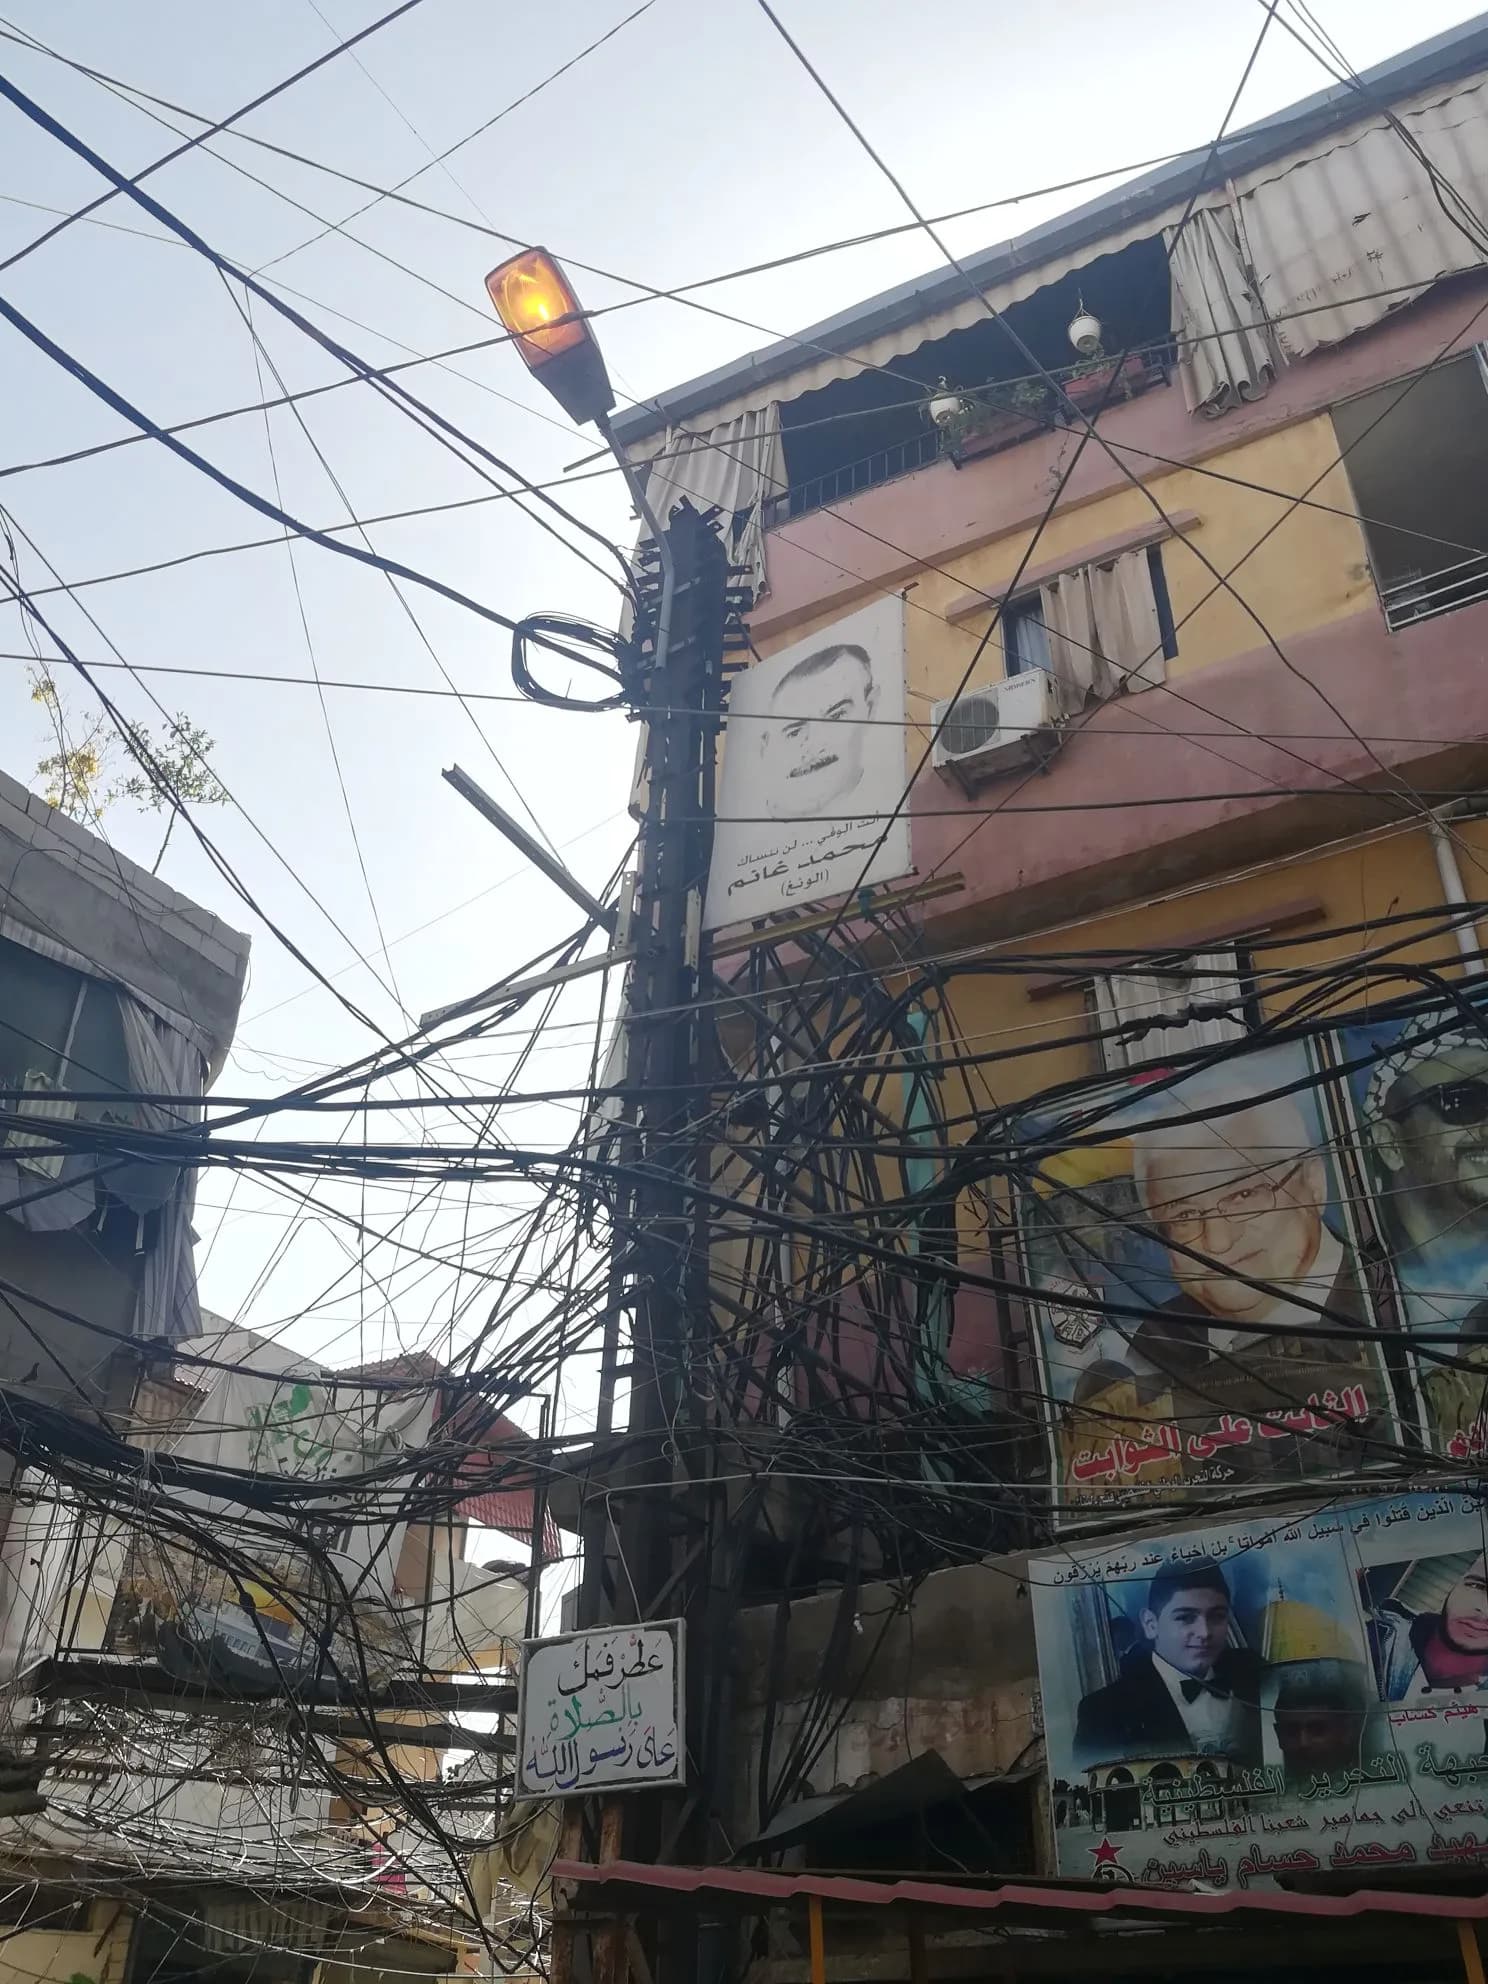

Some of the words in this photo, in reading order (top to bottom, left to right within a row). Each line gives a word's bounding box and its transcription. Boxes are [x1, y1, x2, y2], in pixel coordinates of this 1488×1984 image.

[797, 834, 888, 869] محمد
[728, 861, 790, 896] غانم
[1072, 1421, 1182, 1481] الثوابت
[1187, 1414, 1253, 1460] على
[1308, 1523, 1344, 1540] سبيل
[1350, 1513, 1370, 1533] في
[1141, 1552, 1163, 1566] عند
[1141, 1767, 1286, 1812] الفلسطينية
[1298, 1753, 1408, 1799] التحرير
[1162, 1812, 1256, 1848] الفلسطيني
[1260, 1812, 1310, 1836] شعبنا
[1320, 1806, 1384, 1832] جماهير
[1237, 1842, 1320, 1890] حسام
[1330, 1840, 1417, 1867] محمد
